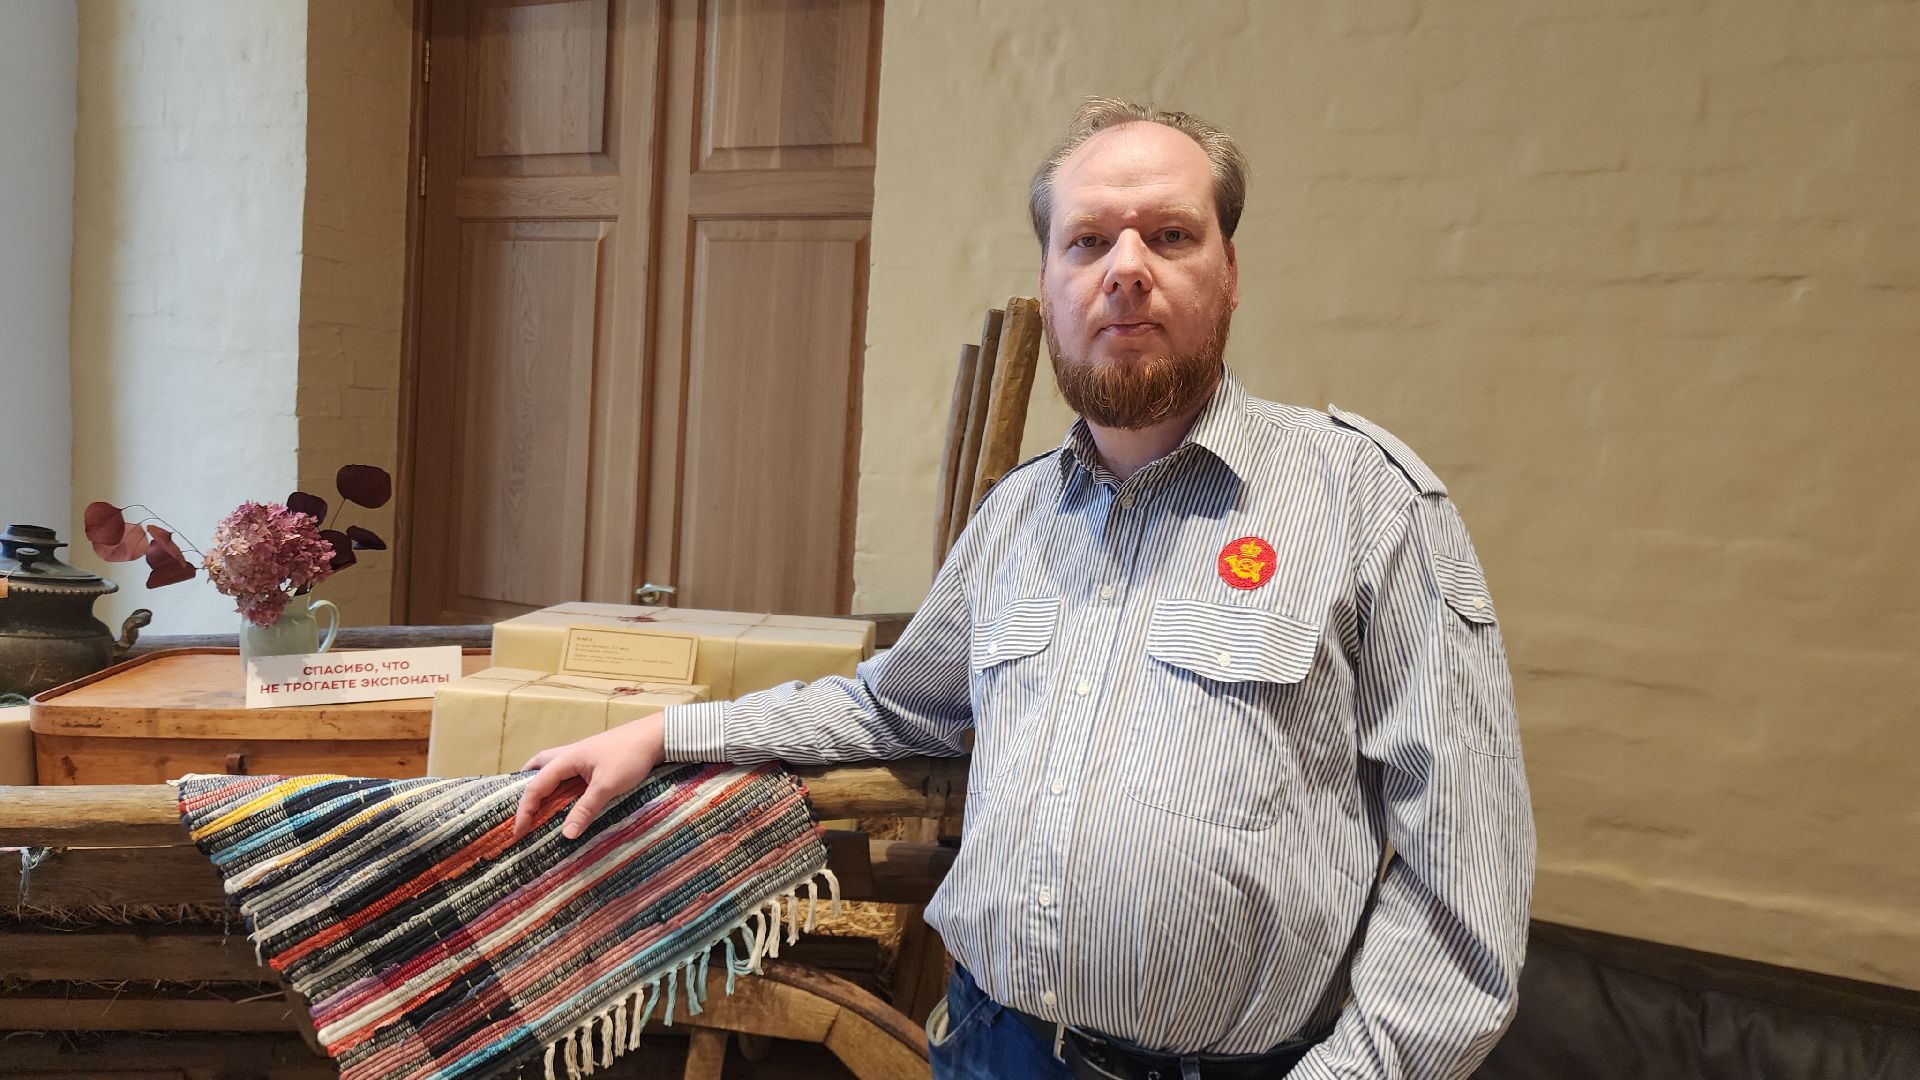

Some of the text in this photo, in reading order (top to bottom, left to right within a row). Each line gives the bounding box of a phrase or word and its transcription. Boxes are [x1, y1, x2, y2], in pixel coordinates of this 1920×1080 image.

[302, 660, 410, 676] СПАСИБО, ЧТО
[260, 673, 449, 694] НЕ ТРОГАЕТЕ ЭКСПОНАТЫ
